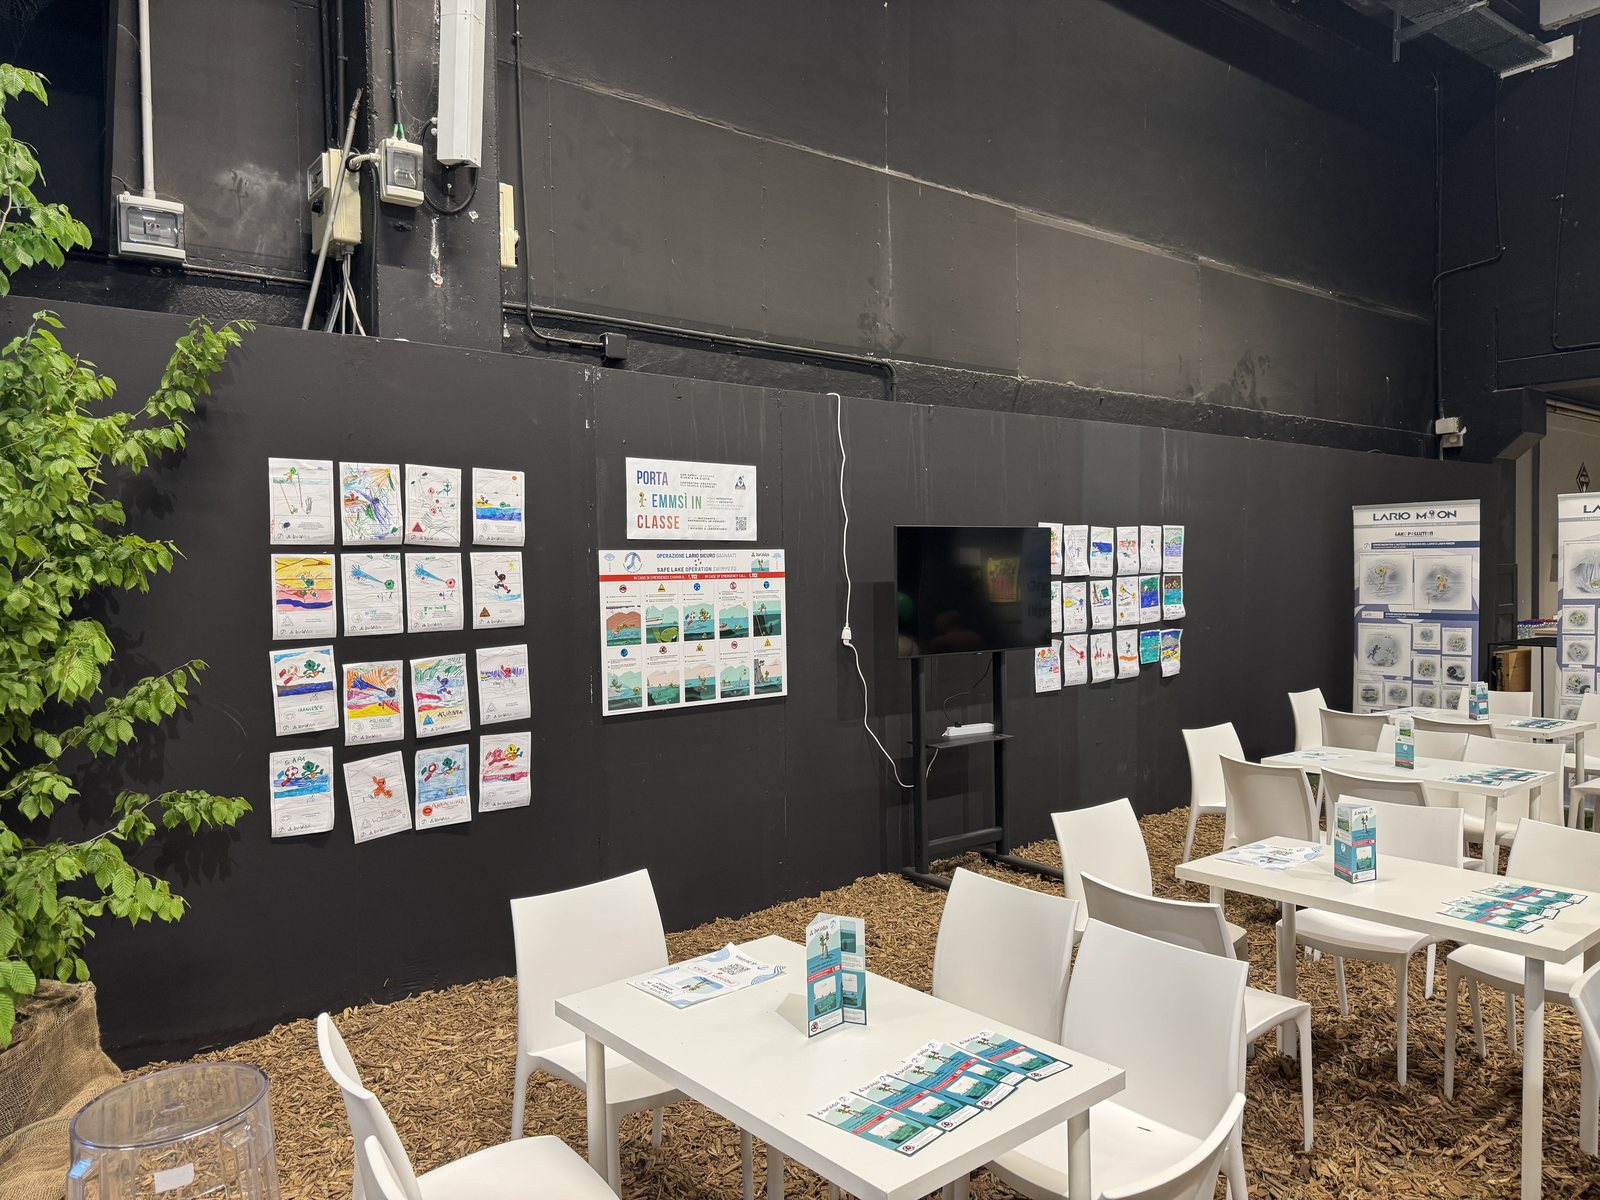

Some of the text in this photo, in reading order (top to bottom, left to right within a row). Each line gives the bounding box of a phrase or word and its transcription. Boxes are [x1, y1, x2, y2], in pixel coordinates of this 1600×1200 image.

[637, 470, 668, 486] PORTA
[652, 493, 687, 509] EMMSÌ
[692, 496, 702, 509] IN
[637, 514, 680, 530] CLASSE
[1373, 512, 1411, 521] LARIO
